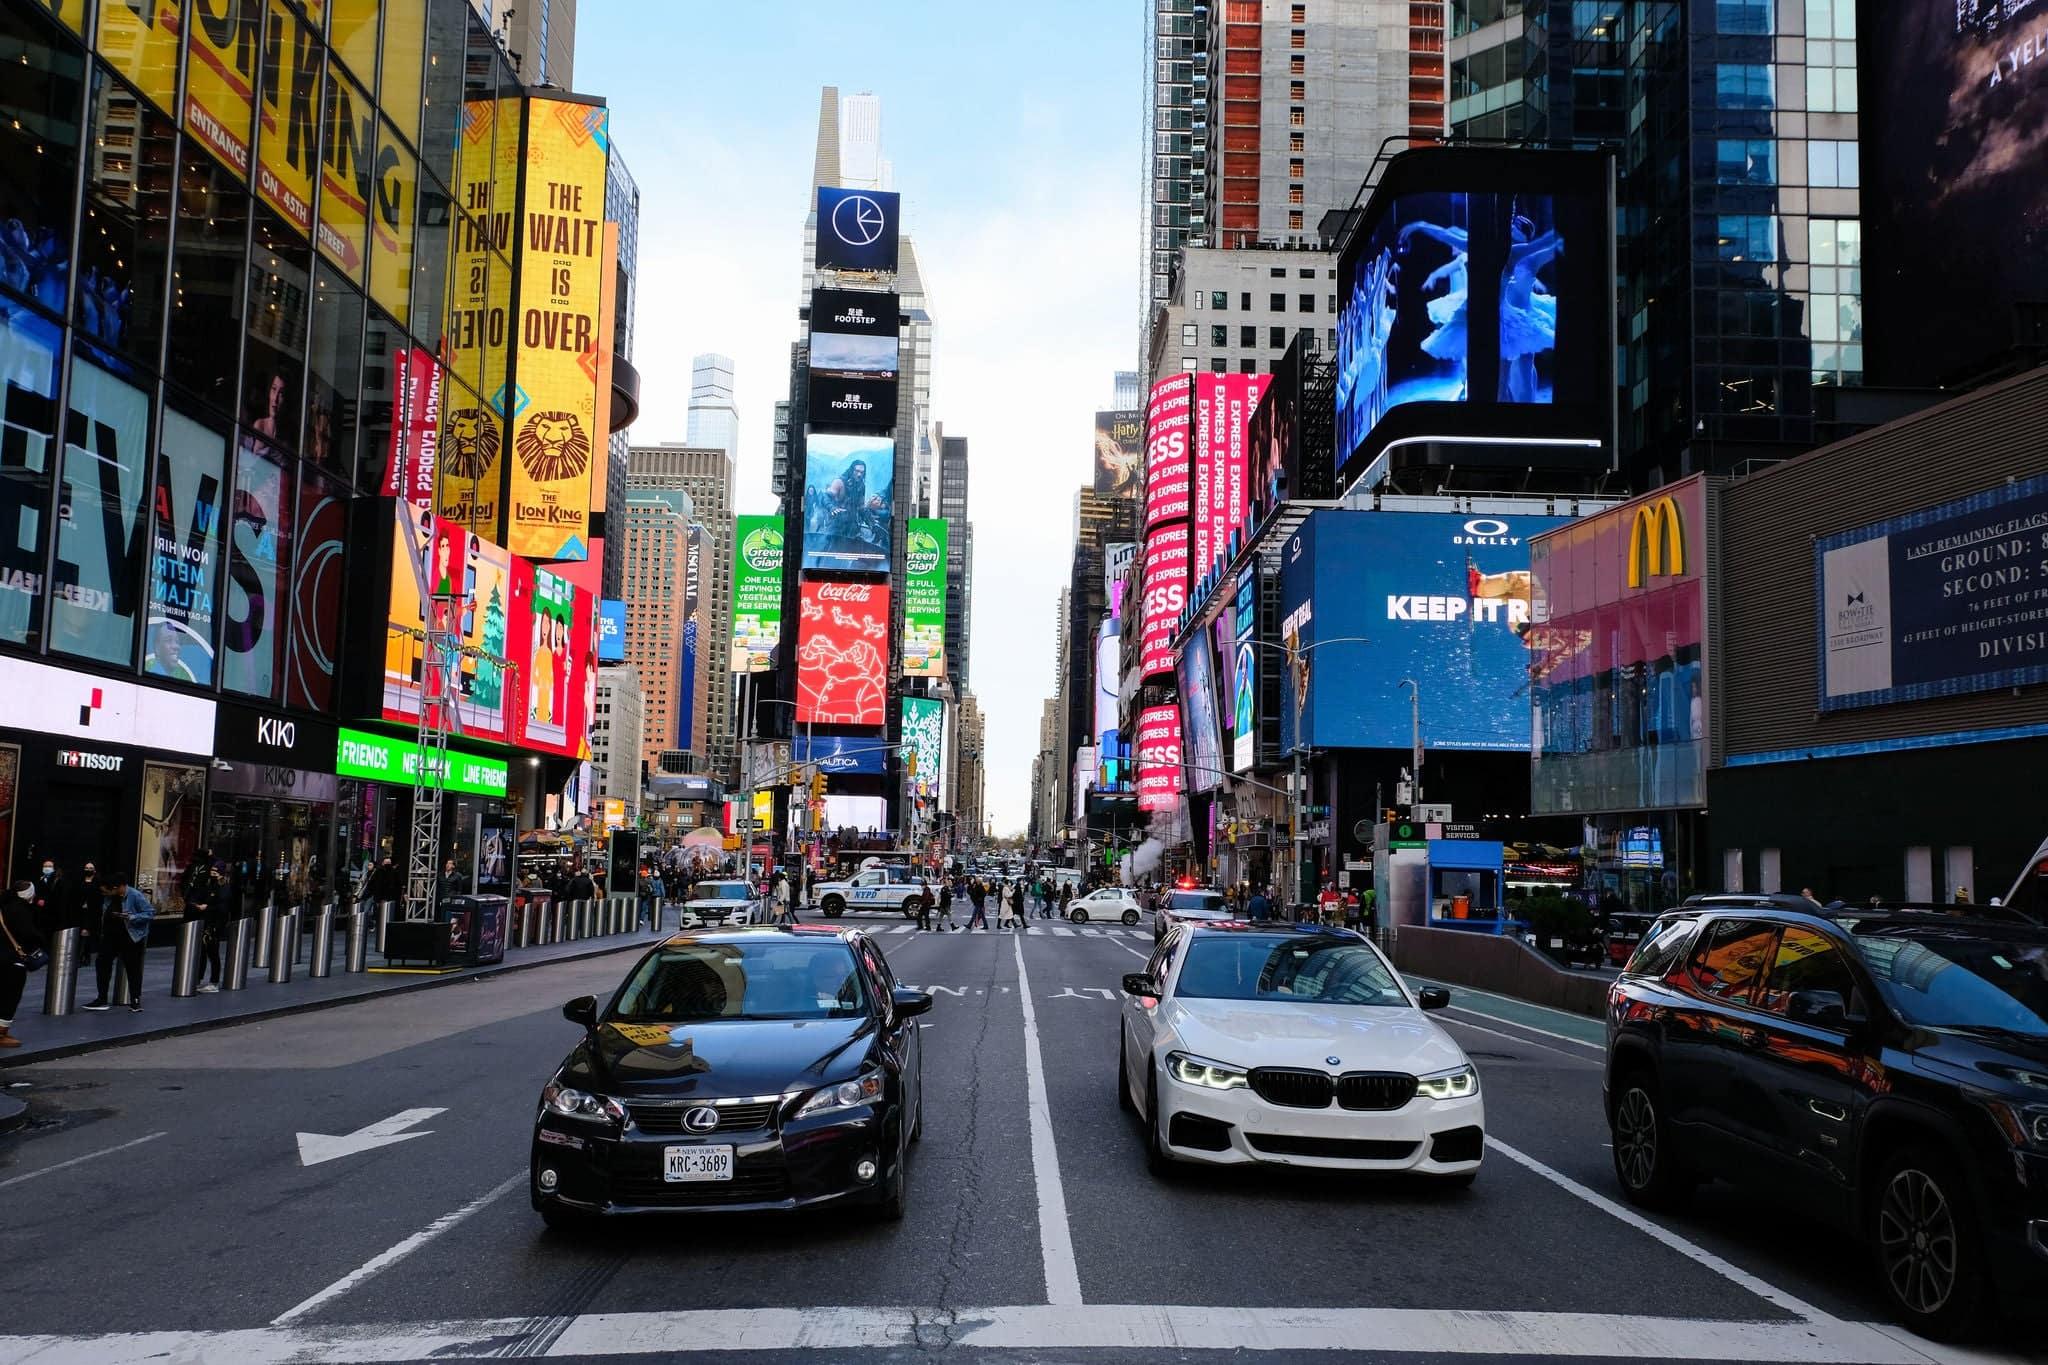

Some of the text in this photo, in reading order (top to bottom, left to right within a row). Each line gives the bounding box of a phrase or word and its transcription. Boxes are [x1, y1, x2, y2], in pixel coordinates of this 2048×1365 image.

[1989, 61, 2003, 88] A
[189, 102, 346, 257] ENTRANCE ON 45TH STREET
[548, 182, 583, 212] THE
[529, 212, 598, 258] WAIT
[551, 268, 571, 296] IS
[524, 308, 592, 355] OVER
[835, 315, 876, 324] FOOTSTEP
[832, 401, 873, 411] FOOTSTEP
[1215, 384, 1226, 445] EXPRESS
[1199, 399, 1209, 459] EXPRESS
[1149, 431, 1185, 469] ESS
[1230, 399, 1241, 525] EXPRESS EXPRESS
[1214, 449, 1225, 510] EXPRESS
[542, 494, 557, 502] THE
[1198, 463, 1209, 524] EXPRESS
[749, 548, 784, 560] Green
[1453, 536, 1520, 545] OAKLEY
[1906, 541, 1934, 559] LAST
[1937, 523, 2004, 551] REMAINING
[751, 557, 784, 570] Giant
[1941, 539, 2032, 573] GROUND:
[928, 589, 940, 597] OF
[1943, 566, 2030, 598] SECOND:
[738, 602, 751, 610] PER
[907, 606, 941, 615] SERVING
[1387, 595, 1467, 621] KEEP
[1473, 597, 1500, 622] IT
[1984, 595, 2011, 610] FEET
[2015, 592, 2030, 603] OF
[600, 617, 615, 626] THE
[1916, 628, 1940, 641] FEET
[1944, 625, 1958, 637] OF
[257, 716, 295, 749] KIKO
[79, 752, 124, 772] TISSOT
[342, 740, 388, 770] FRIENDS
[463, 763, 480, 784] LINE
[813, 757, 859, 768] NAUTICA
[264, 767, 296, 788] KIKO
[854, 890, 877, 899] NYPD
[670, 1154, 728, 1173] KRC 3689
